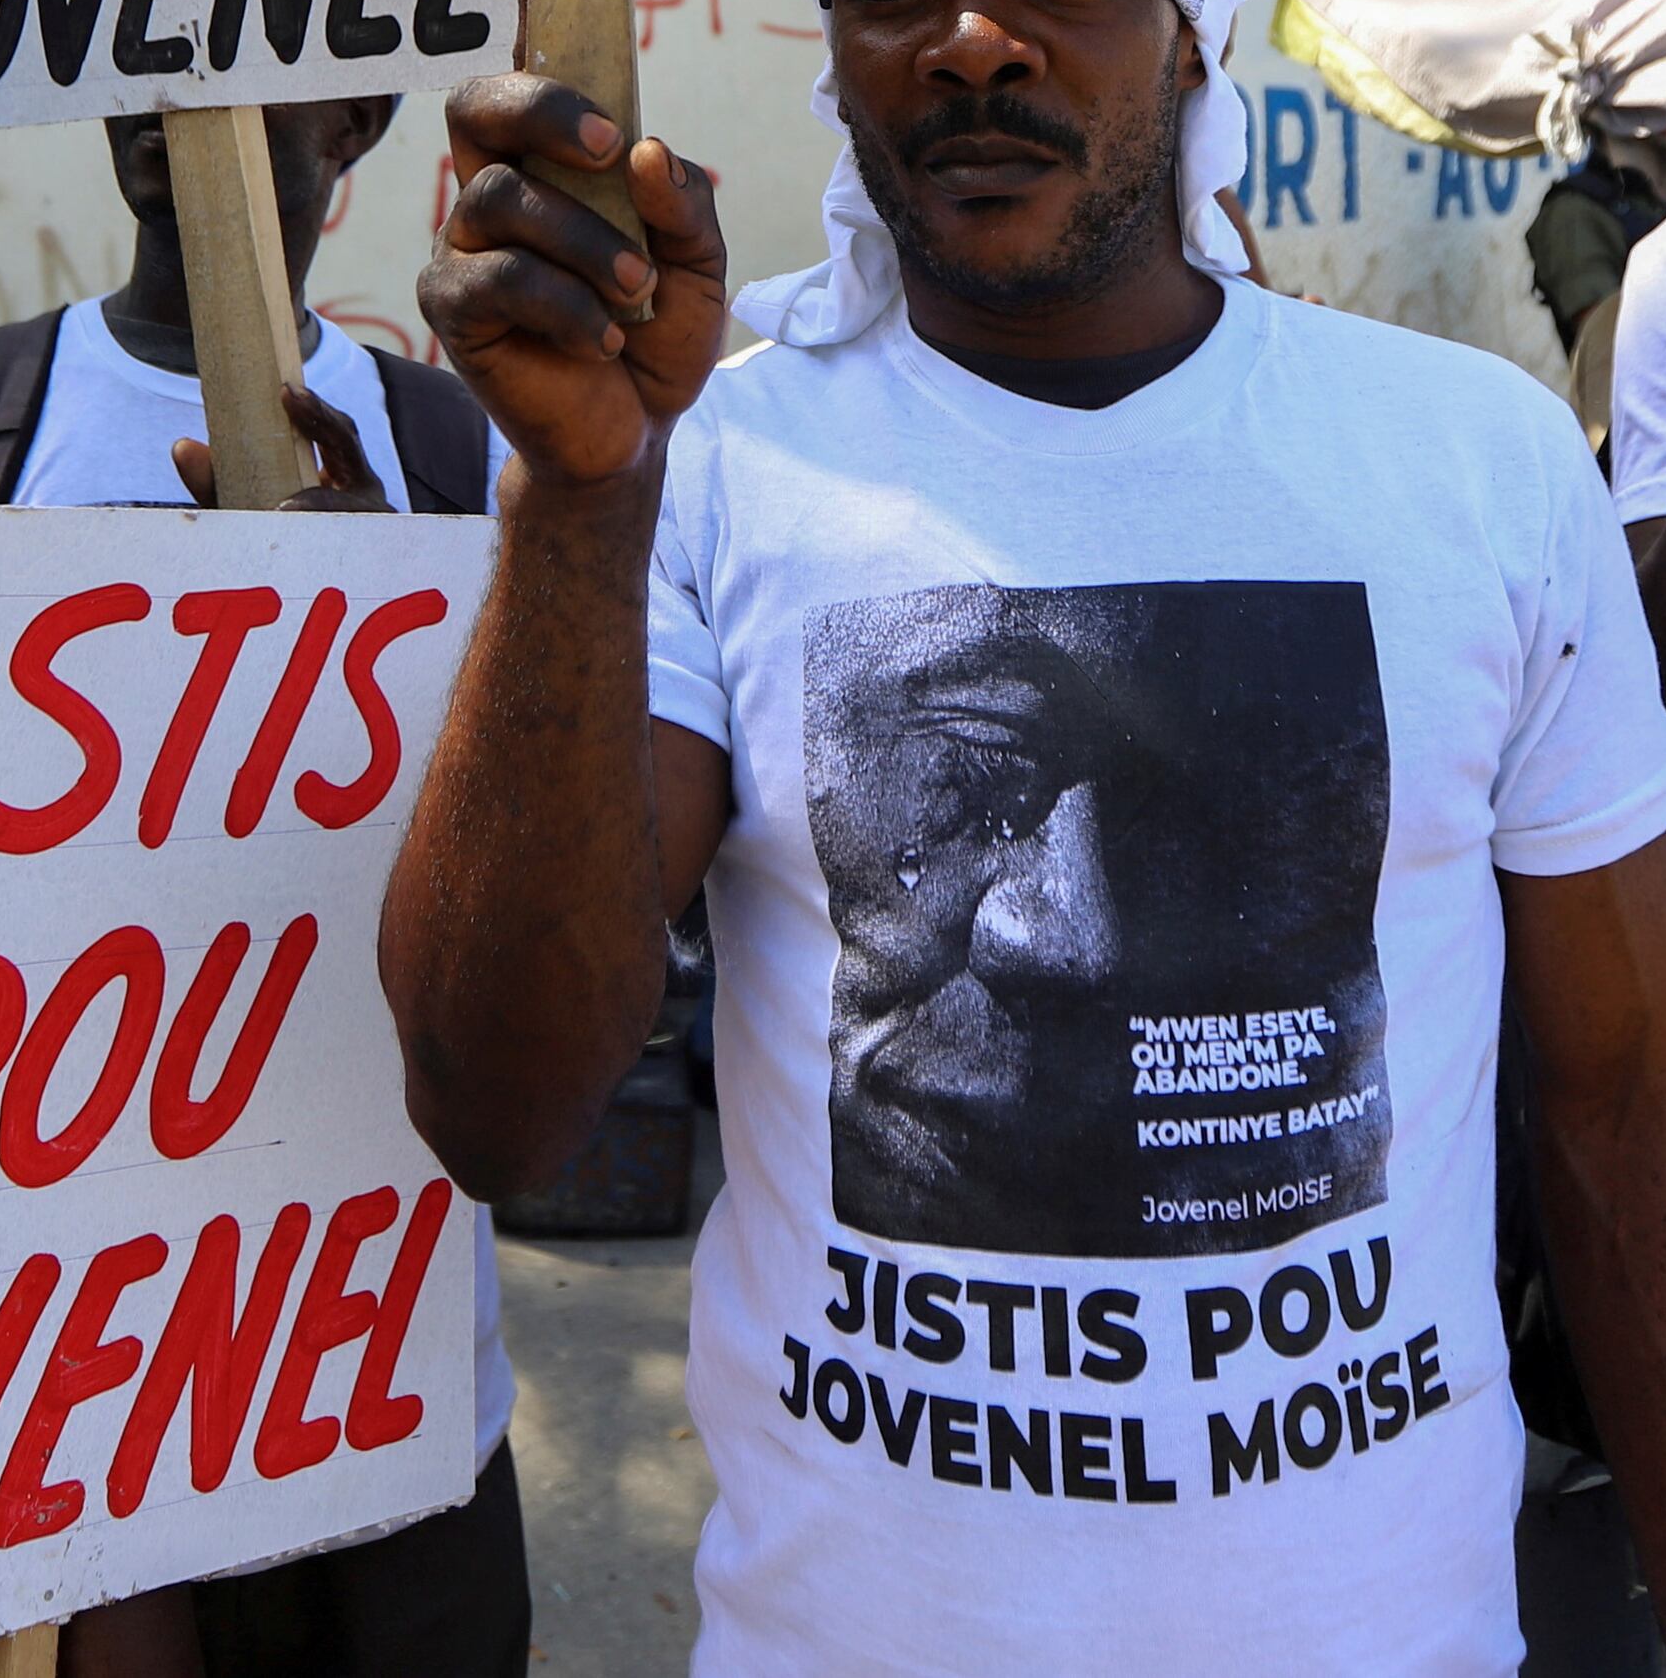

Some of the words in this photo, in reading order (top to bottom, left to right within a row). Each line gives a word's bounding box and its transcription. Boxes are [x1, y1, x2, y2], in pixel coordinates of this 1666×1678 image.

[1244, 1005, 1337, 1035] ESEYE,
[1130, 1041, 1177, 1069] OU
[1183, 1036, 1279, 1068] MEN'M
[1283, 1031, 1327, 1060] PA
[1133, 1060, 1309, 1096] ABANDONE.
[1137, 1112, 1284, 1148] KONTINYE
[1141, 1190, 1250, 1224] Jovenel
[1254, 1173, 1334, 1217] MOISE
[824, 1245, 1148, 1384] JISTIS
[1183, 1235, 1393, 1382] POU
[779, 1332, 1178, 1504] JOVENEL
[1207, 1325, 1452, 1497] MOÏSE
